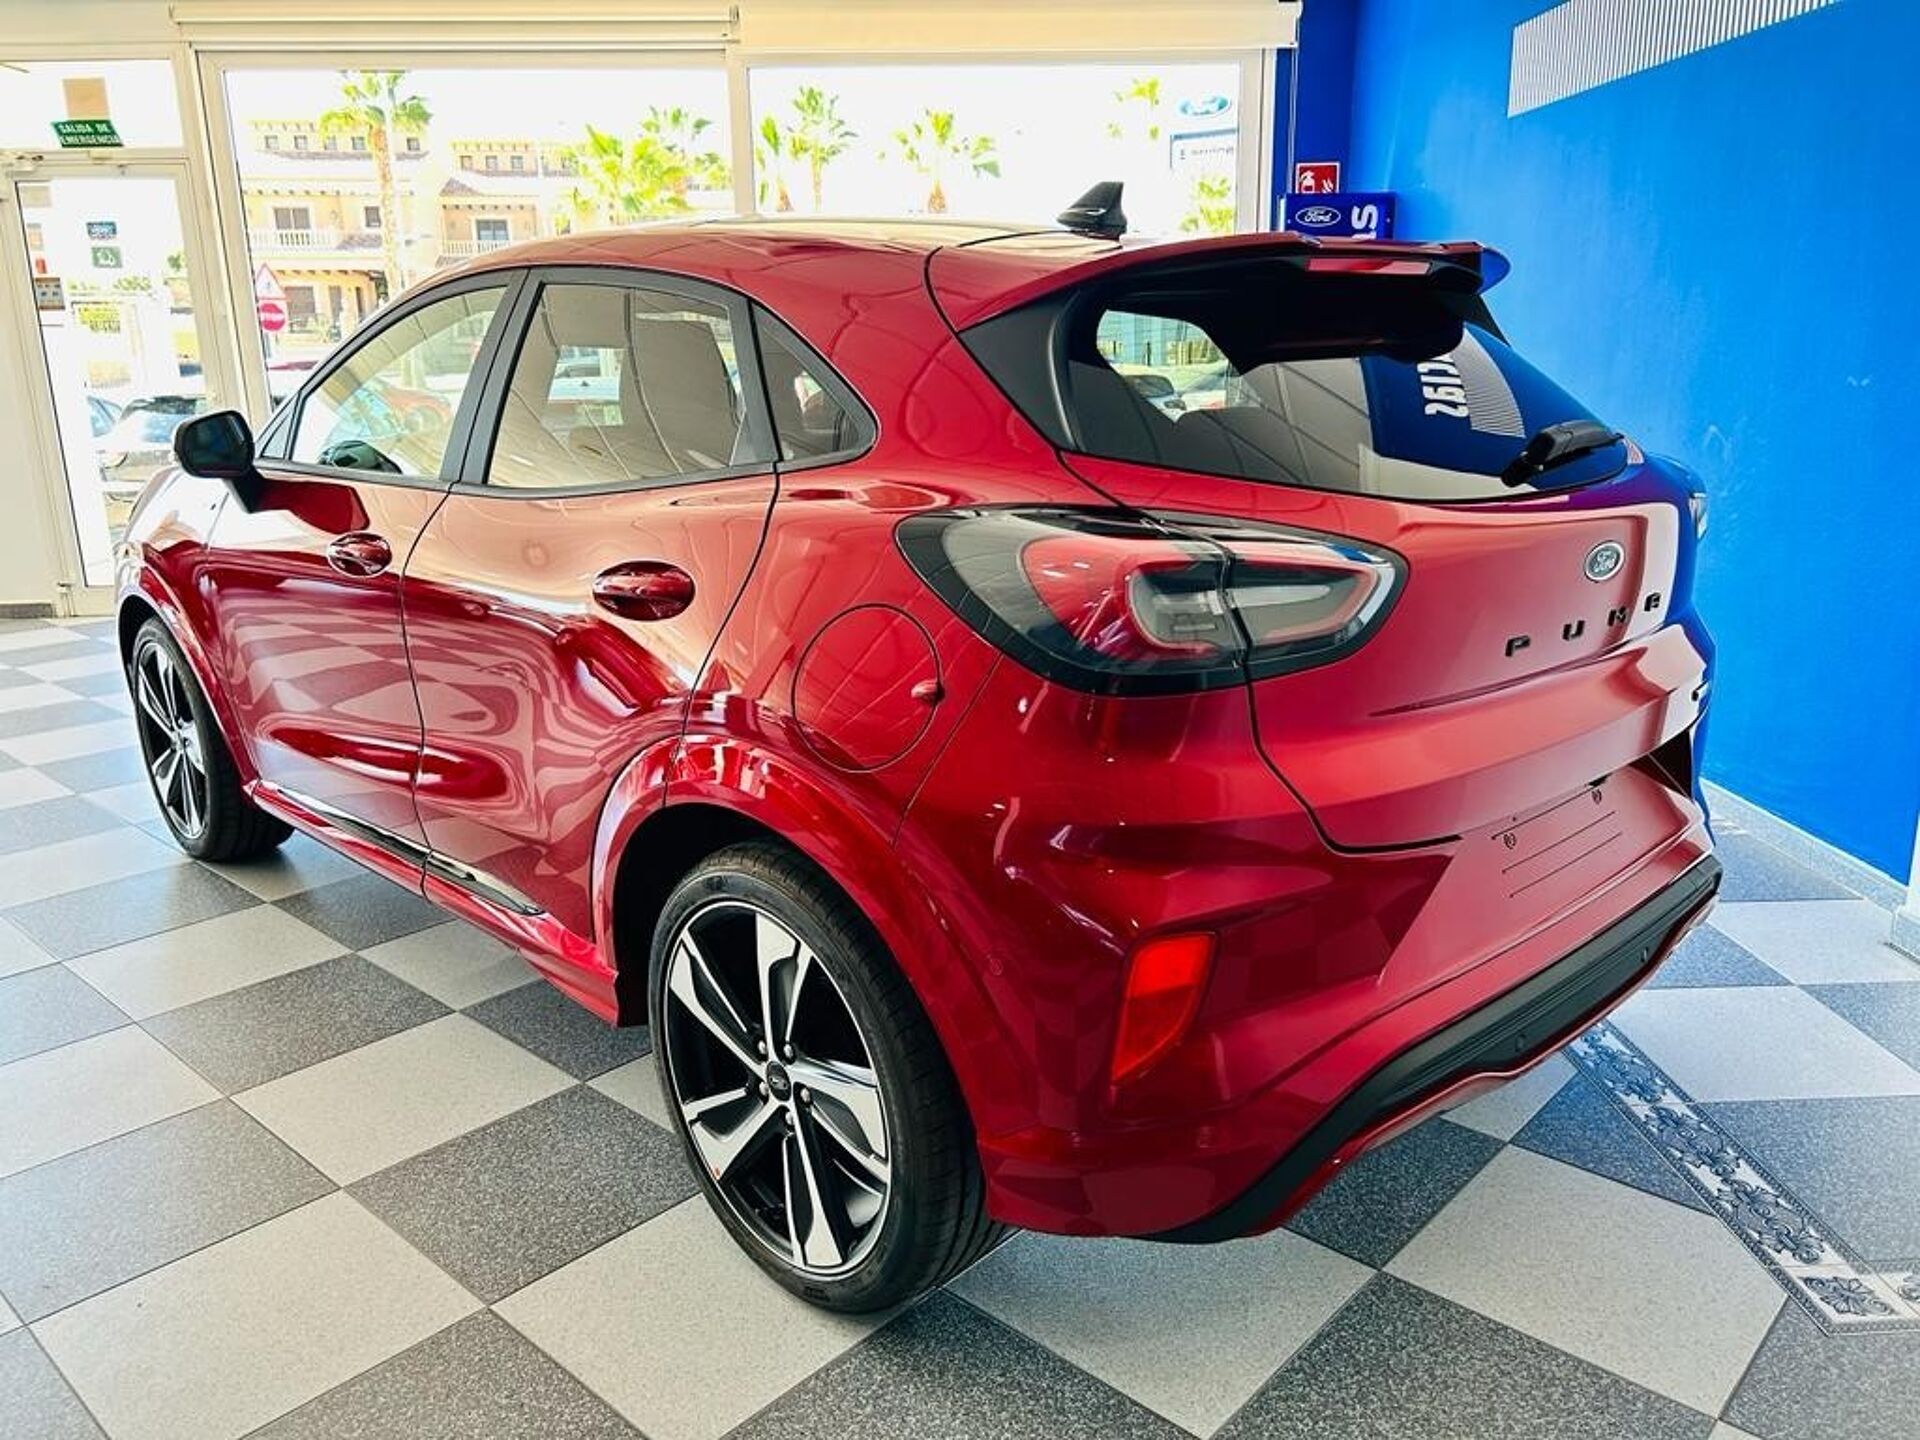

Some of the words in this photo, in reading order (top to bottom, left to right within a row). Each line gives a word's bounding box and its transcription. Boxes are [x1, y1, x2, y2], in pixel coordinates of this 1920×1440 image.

[58, 123, 94, 134] SALIDA
[95, 123, 111, 134] DE
[1505, 592, 1661, 657] PUMA
